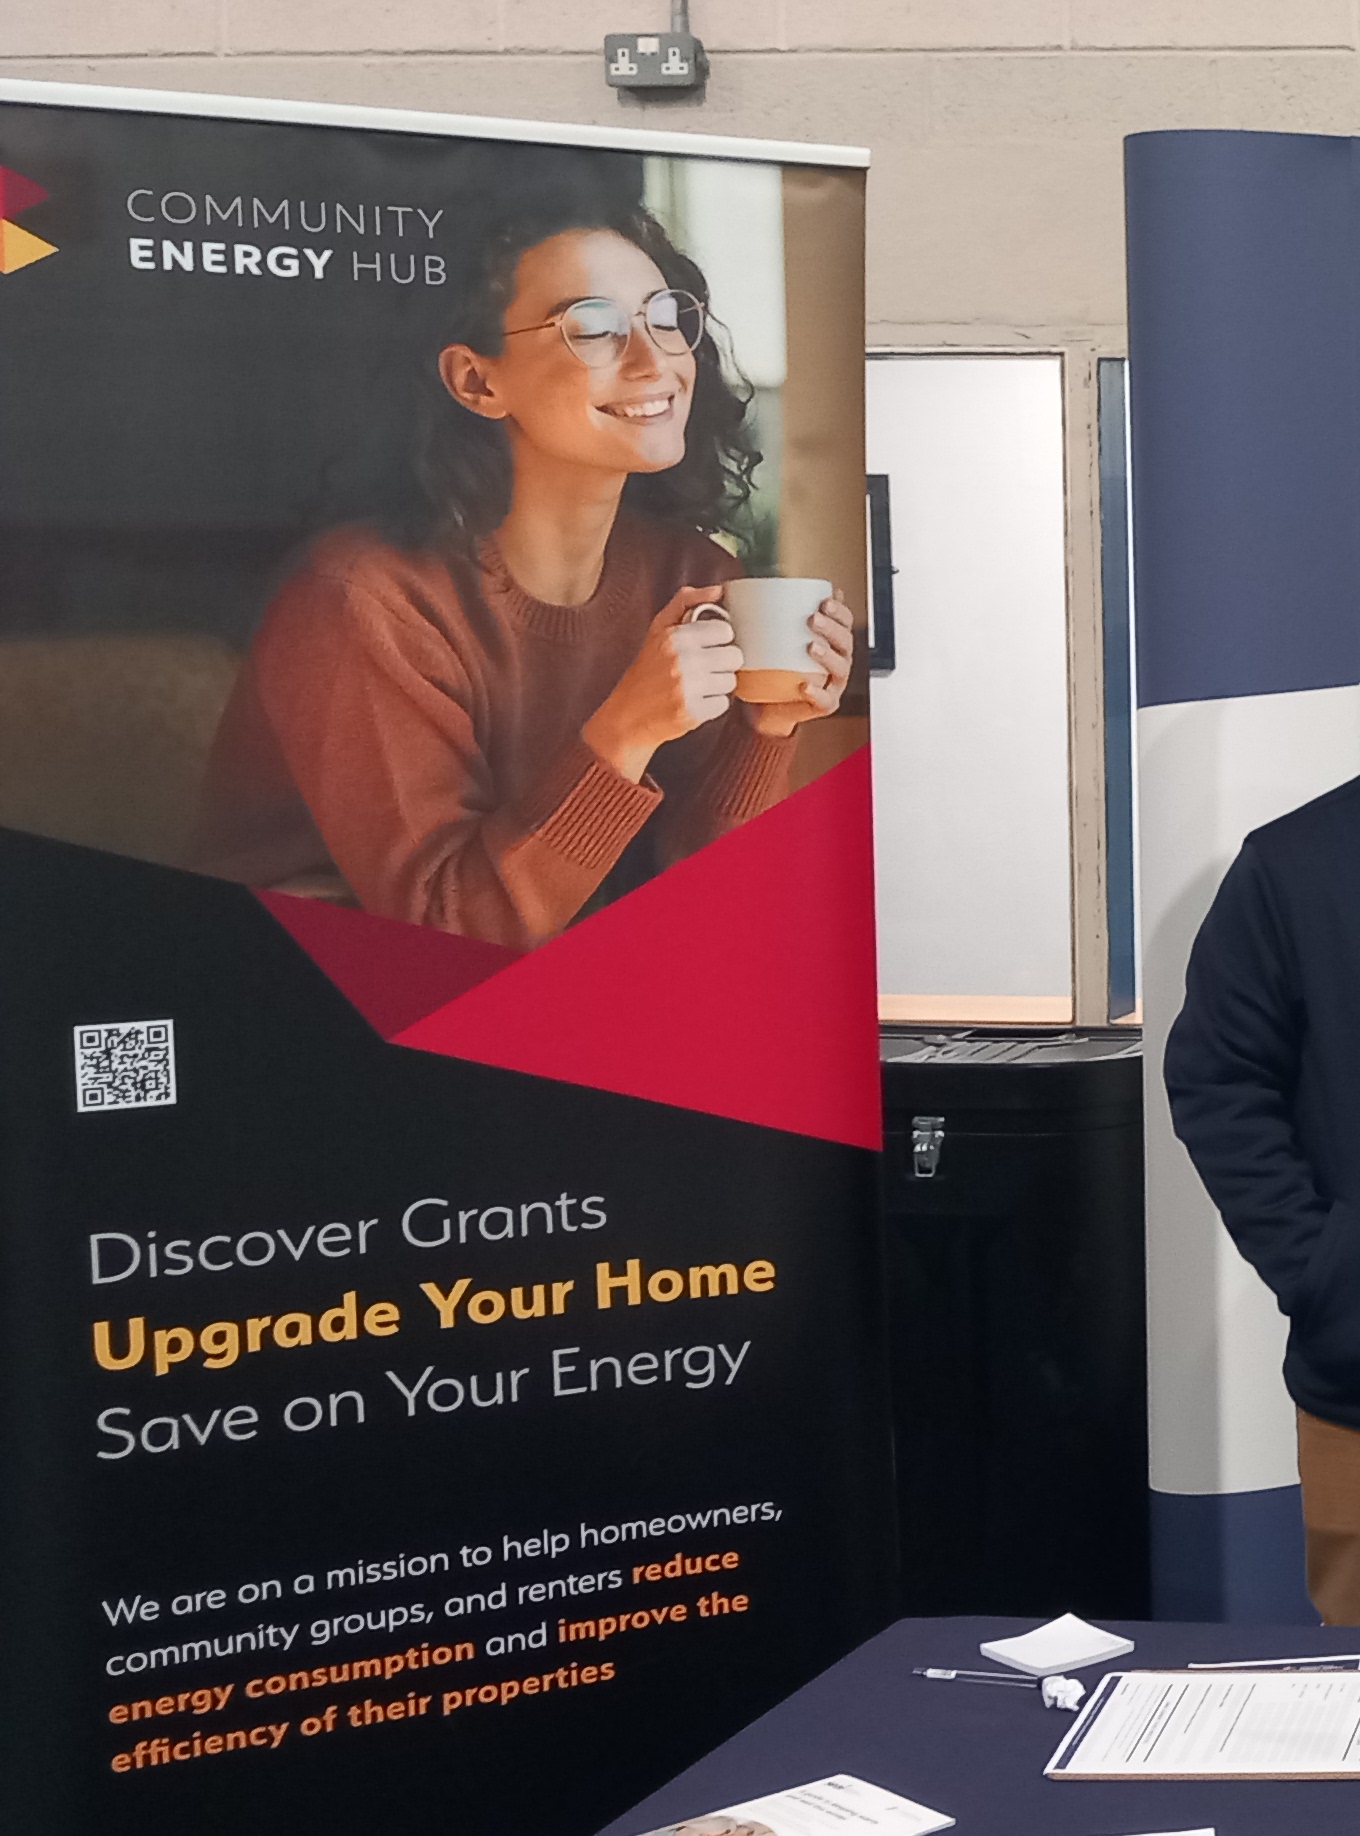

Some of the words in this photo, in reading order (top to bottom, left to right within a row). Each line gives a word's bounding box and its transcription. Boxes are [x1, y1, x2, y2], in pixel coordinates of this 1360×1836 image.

[127, 188, 443, 239] COMMUNITY
[129, 237, 333, 280] ENERGY
[353, 250, 446, 285] HUB
[90, 1215, 378, 1285] Discover
[401, 1192, 607, 1249] Grants
[92, 1291, 400, 1376] Upgrade
[419, 1277, 575, 1329] Your
[595, 1257, 778, 1310] Home
[96, 1403, 260, 1460] Save
[283, 1388, 365, 1432] on
[385, 1365, 529, 1417] Your
[551, 1340, 752, 1397] Energy
[102, 1595, 160, 1626] We
[171, 1589, 227, 1616] are
[237, 1578, 282, 1604] on
[293, 1573, 315, 1595] a
[326, 1552, 449, 1589] mission
[460, 1544, 492, 1568] to
[503, 1528, 570, 1562] help
[580, 1501, 783, 1549] homeowners,
[105, 1623, 300, 1676] community
[310, 1602, 434, 1646] groups,
[444, 1582, 507, 1617] and
[517, 1568, 622, 1605] renters
[632, 1551, 740, 1584] reduce
[108, 1683, 235, 1725] energy
[245, 1640, 475, 1698] consumption
[486, 1621, 547, 1656] and
[558, 1601, 688, 1642] improve
[696, 1590, 750, 1618] the
[110, 1721, 290, 1774] efficiency
[300, 1704, 338, 1737] of
[347, 1691, 432, 1728] their
[442, 1661, 615, 1716] properties
